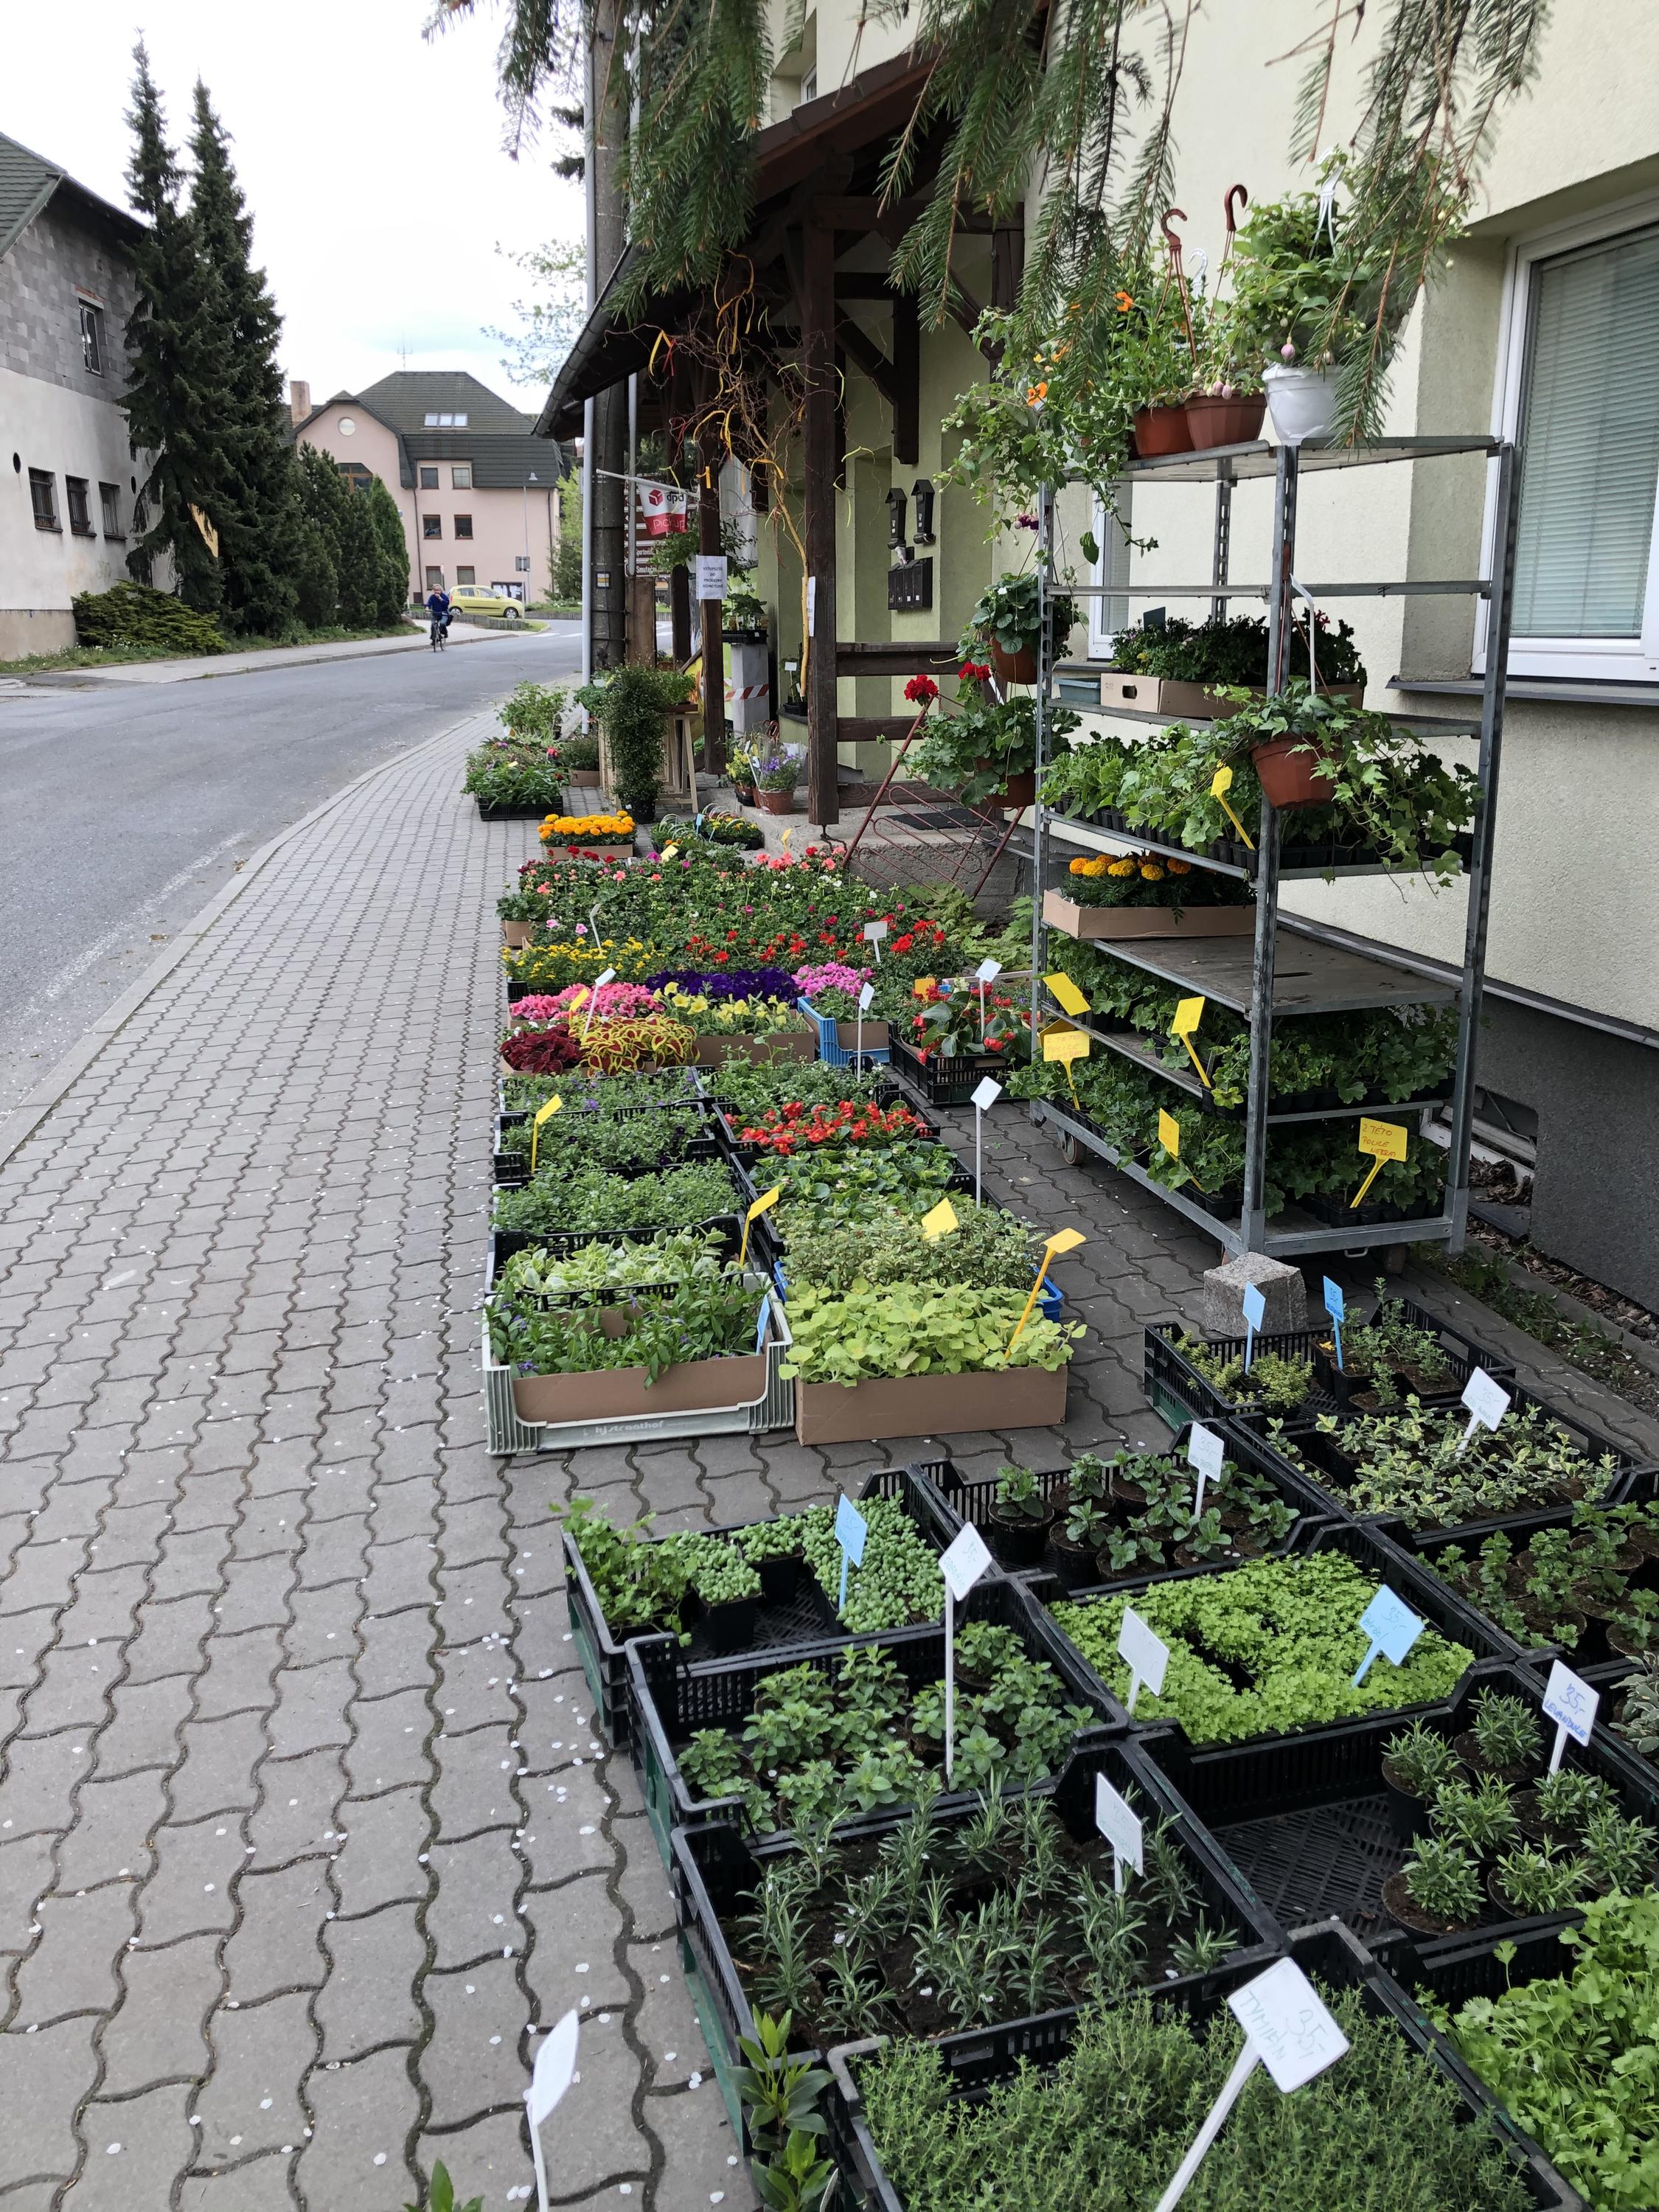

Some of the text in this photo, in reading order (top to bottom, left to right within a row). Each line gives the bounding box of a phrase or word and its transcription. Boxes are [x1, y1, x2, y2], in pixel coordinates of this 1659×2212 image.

[667, 491, 685, 504] dpd
[1370, 1124, 1393, 1136] TÉTO
[1362, 1136, 1390, 1147] POLICE
[1544, 1698, 1587, 1739] LEVANDULE
[1239, 1990, 1288, 2062] TYMIÁN
